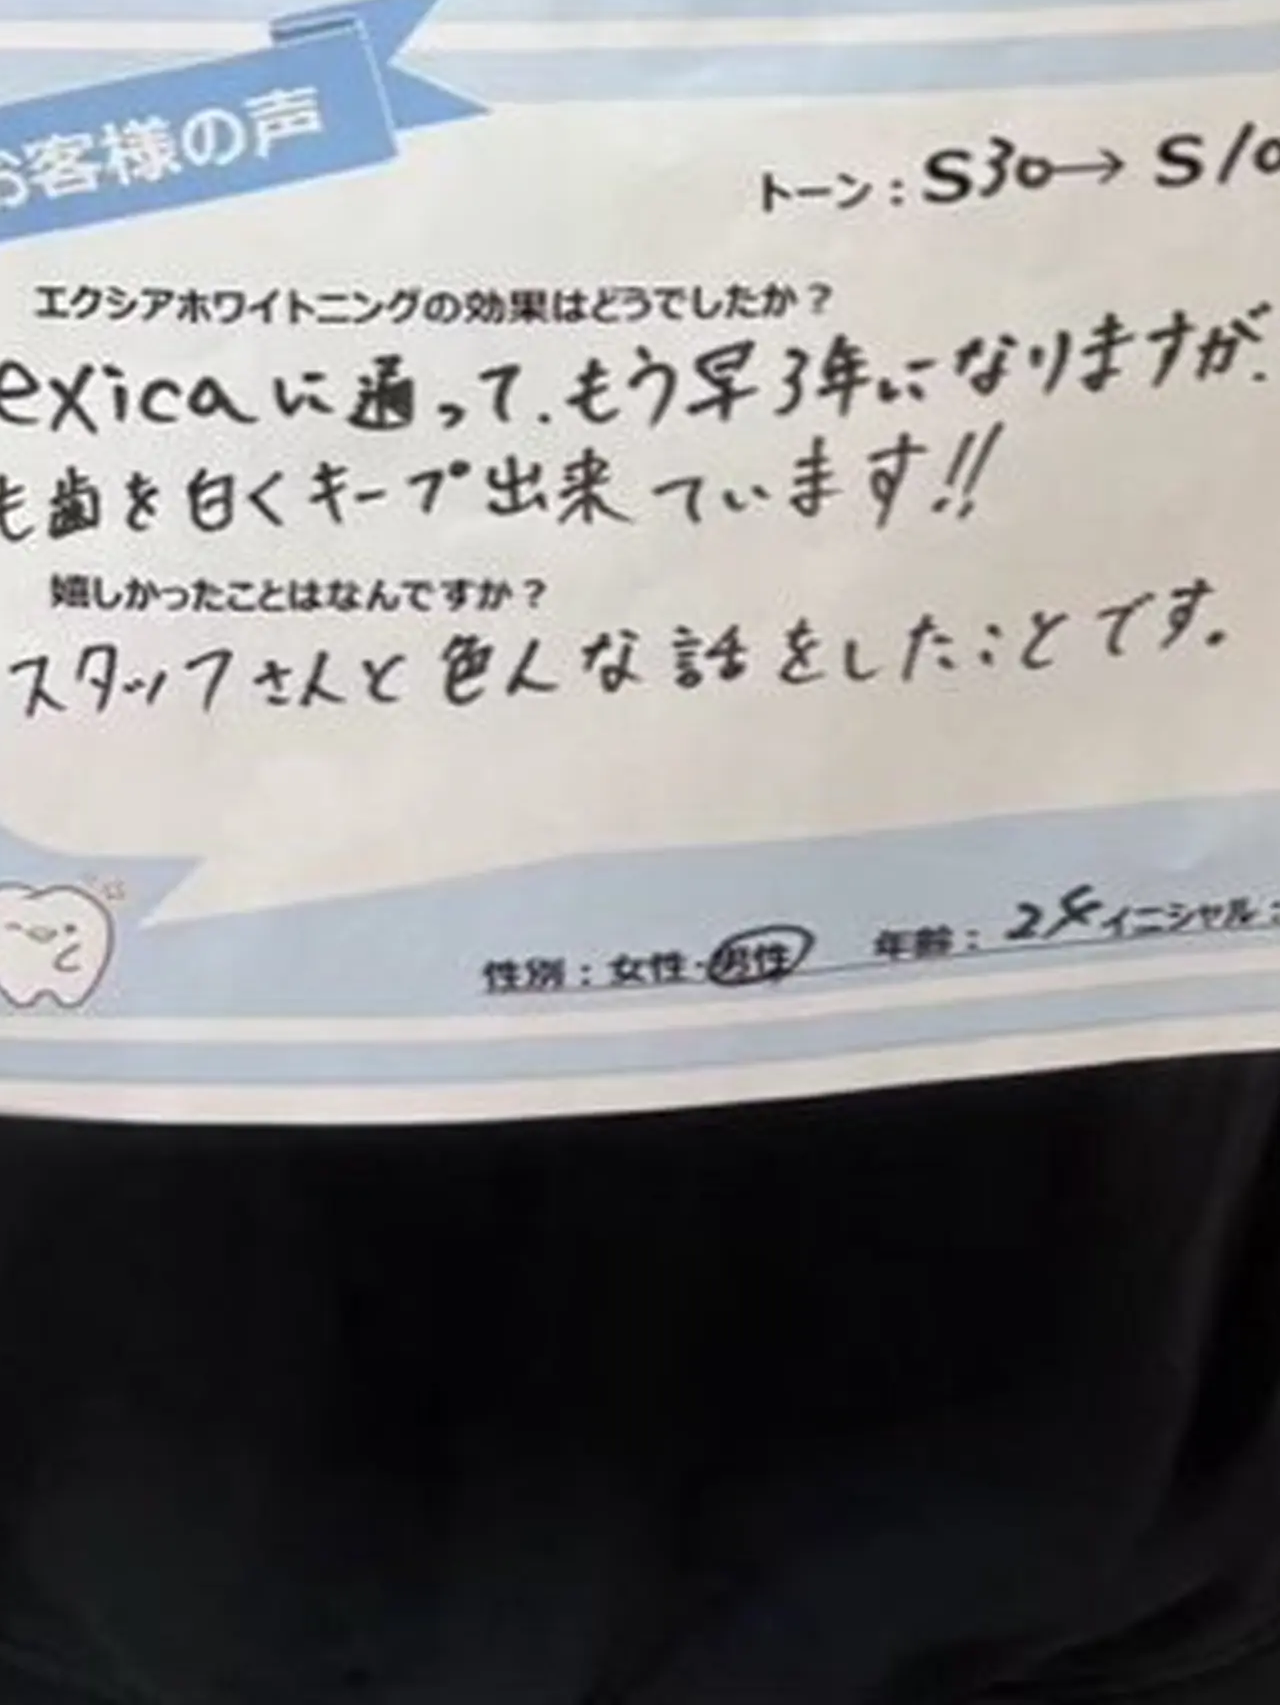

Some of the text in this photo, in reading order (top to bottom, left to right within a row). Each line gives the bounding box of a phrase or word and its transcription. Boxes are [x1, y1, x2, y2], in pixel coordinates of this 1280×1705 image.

[33, 281, 834, 326] エクシアホワイトニングの効果はどうでしたか？
[48, 572, 548, 614] 嬉しかったことはなんですか？
